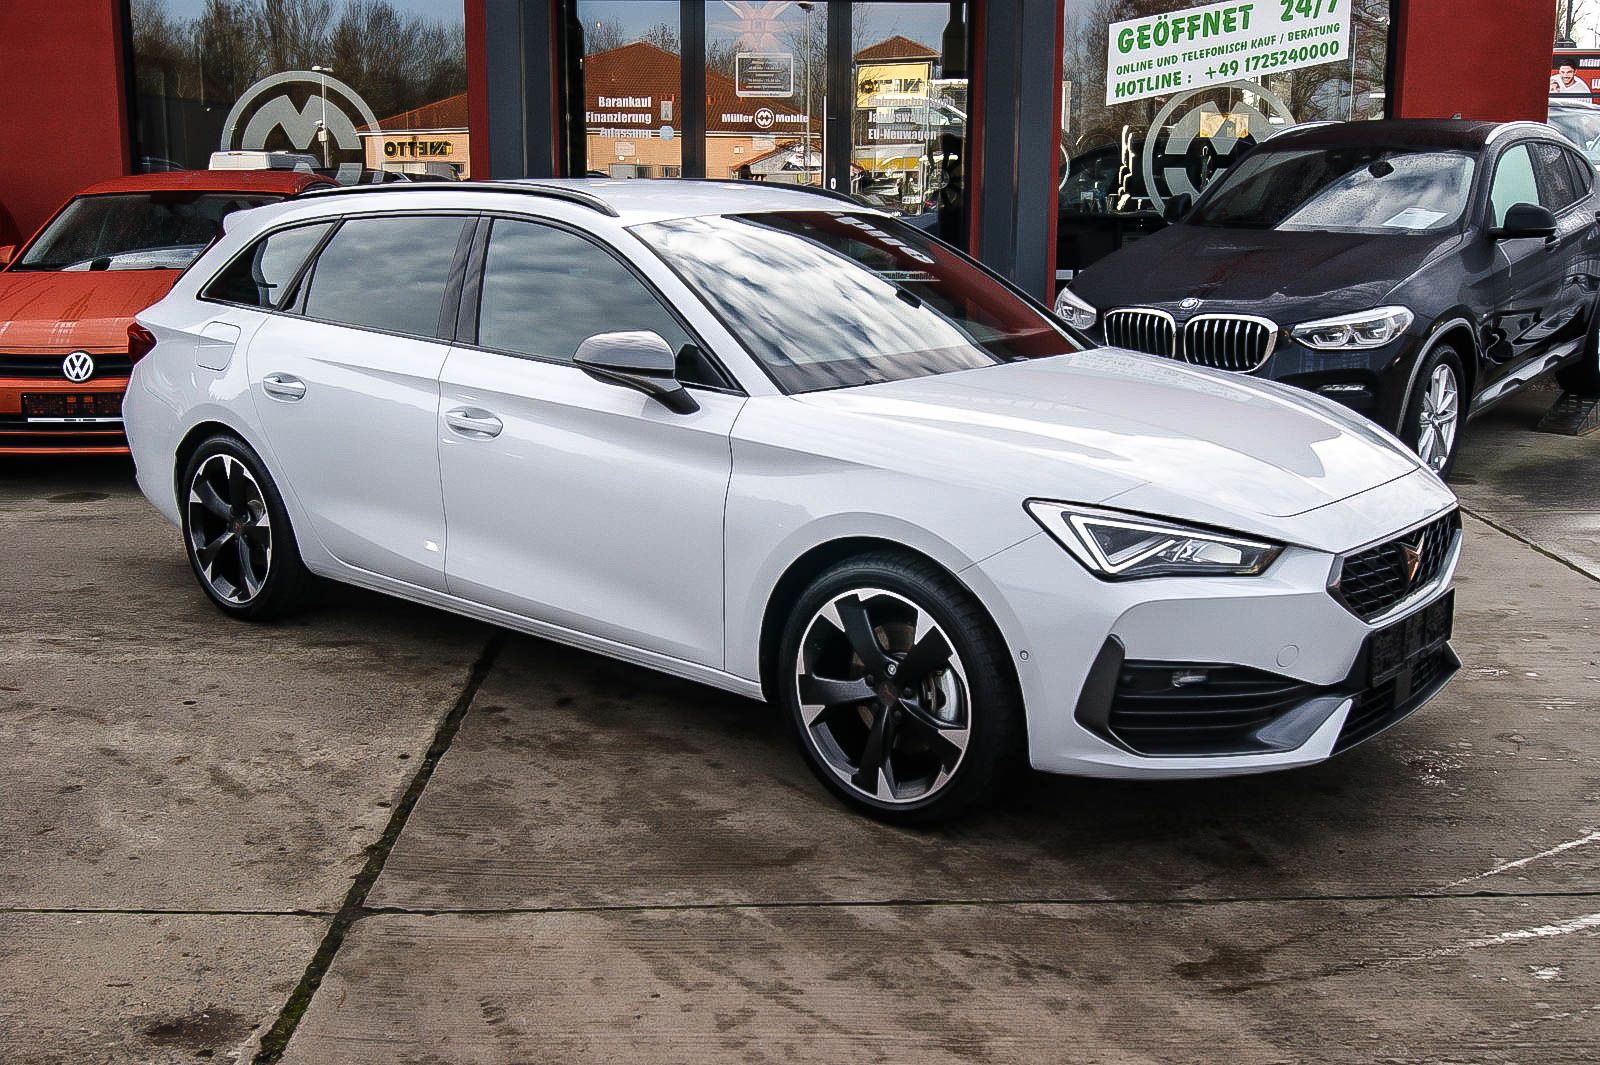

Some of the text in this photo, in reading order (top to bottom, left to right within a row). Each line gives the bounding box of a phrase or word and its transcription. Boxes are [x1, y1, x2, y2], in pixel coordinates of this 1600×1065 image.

[1117, 4, 1254, 53] GEÖFFNET
[1116, 59, 1153, 75] ONLINE
[1157, 55, 1178, 68] UND
[1182, 41, 1247, 62] TELEFONISCH
[1251, 35, 1277, 50] KAUF
[1288, 23, 1340, 41] BERATUNG
[1115, 71, 1181, 97] HOTLINE
[1205, 60, 1239, 79] +49
[1245, 40, 1339, 72] 1725240000
[585, 112, 652, 124] Finanzierung
[721, 113, 754, 123] Müller
[868, 128, 937, 141] EU-Neuwagen
